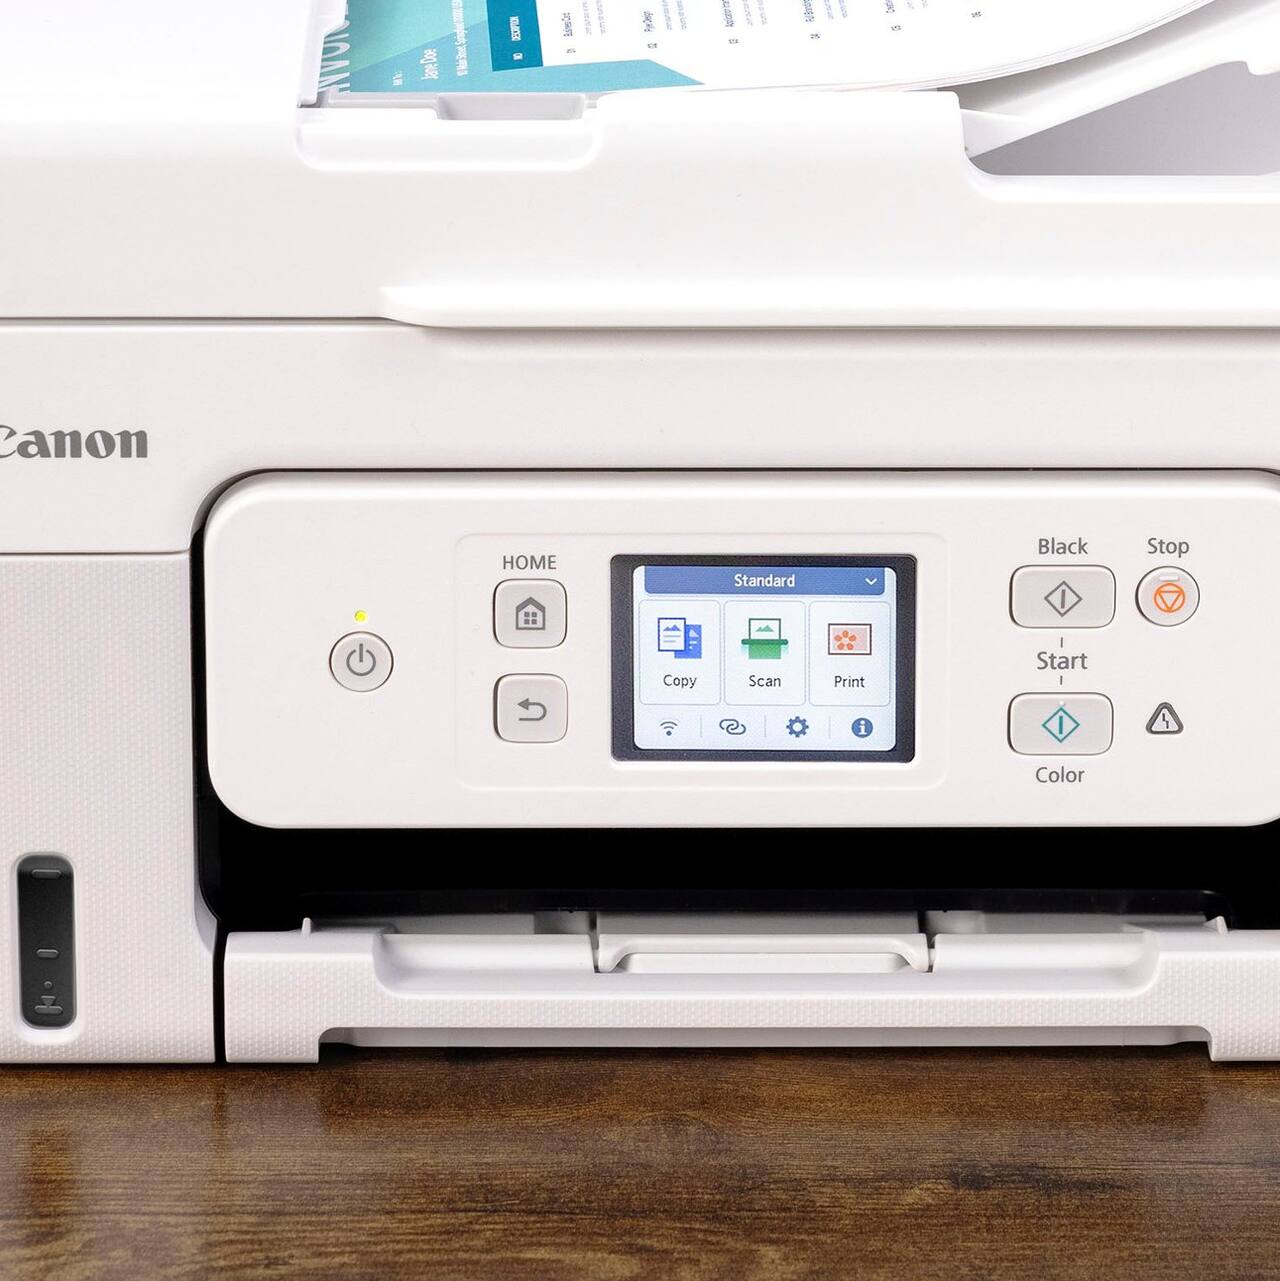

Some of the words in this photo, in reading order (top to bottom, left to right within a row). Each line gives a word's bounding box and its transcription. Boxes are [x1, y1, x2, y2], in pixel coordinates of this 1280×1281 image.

[420, 48, 437, 64] Doe
[421, 64, 439, 80] Jane
[1038, 536, 1088, 555] Black
[1147, 537, 1190, 559] Stop
[502, 554, 557, 570] HOME
[734, 573, 796, 588] Standard
[1036, 652, 1088, 671] Start
[663, 674, 697, 689] Copy
[749, 674, 782, 688] Scan
[834, 675, 865, 688] Print
[1035, 765, 1085, 784] Color
